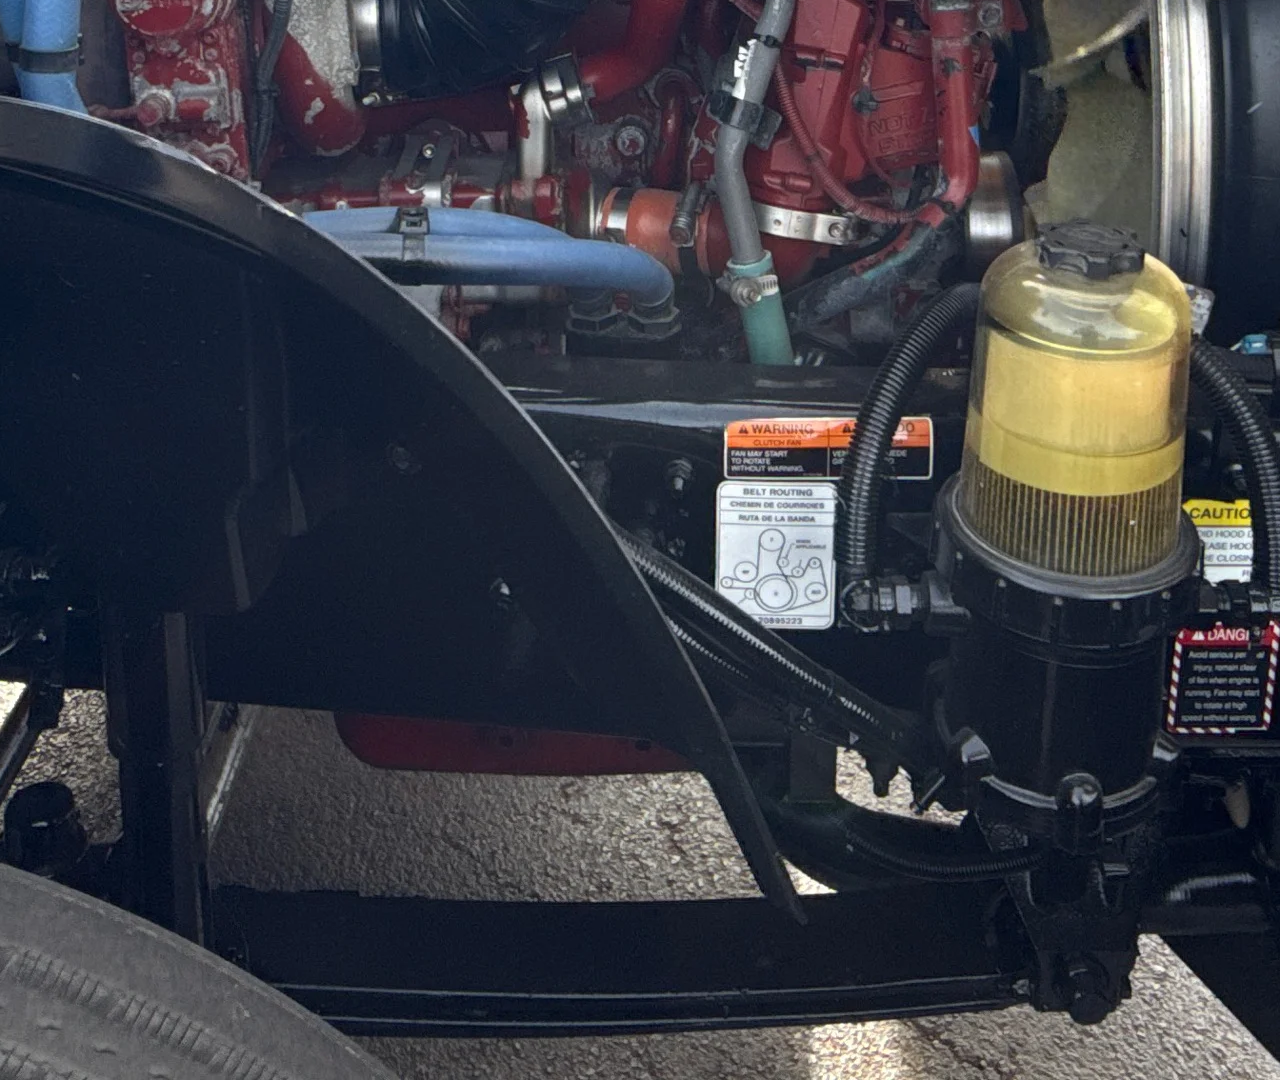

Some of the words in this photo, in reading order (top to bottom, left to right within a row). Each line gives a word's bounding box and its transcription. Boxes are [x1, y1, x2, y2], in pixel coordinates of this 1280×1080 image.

[752, 423, 814, 434] WARNING
[743, 488, 767, 496] BELT
[769, 488, 813, 497] ROUTING
[1189, 507, 1251, 519] CAUTIO
[1215, 530, 1245, 538] HOOD
[1230, 542, 1252, 550] HOO
[1208, 628, 1250, 641] DANG
[1228, 678, 1252, 686] engine
[1232, 702, 1248, 711] high
[1181, 715, 1203, 723] speed
